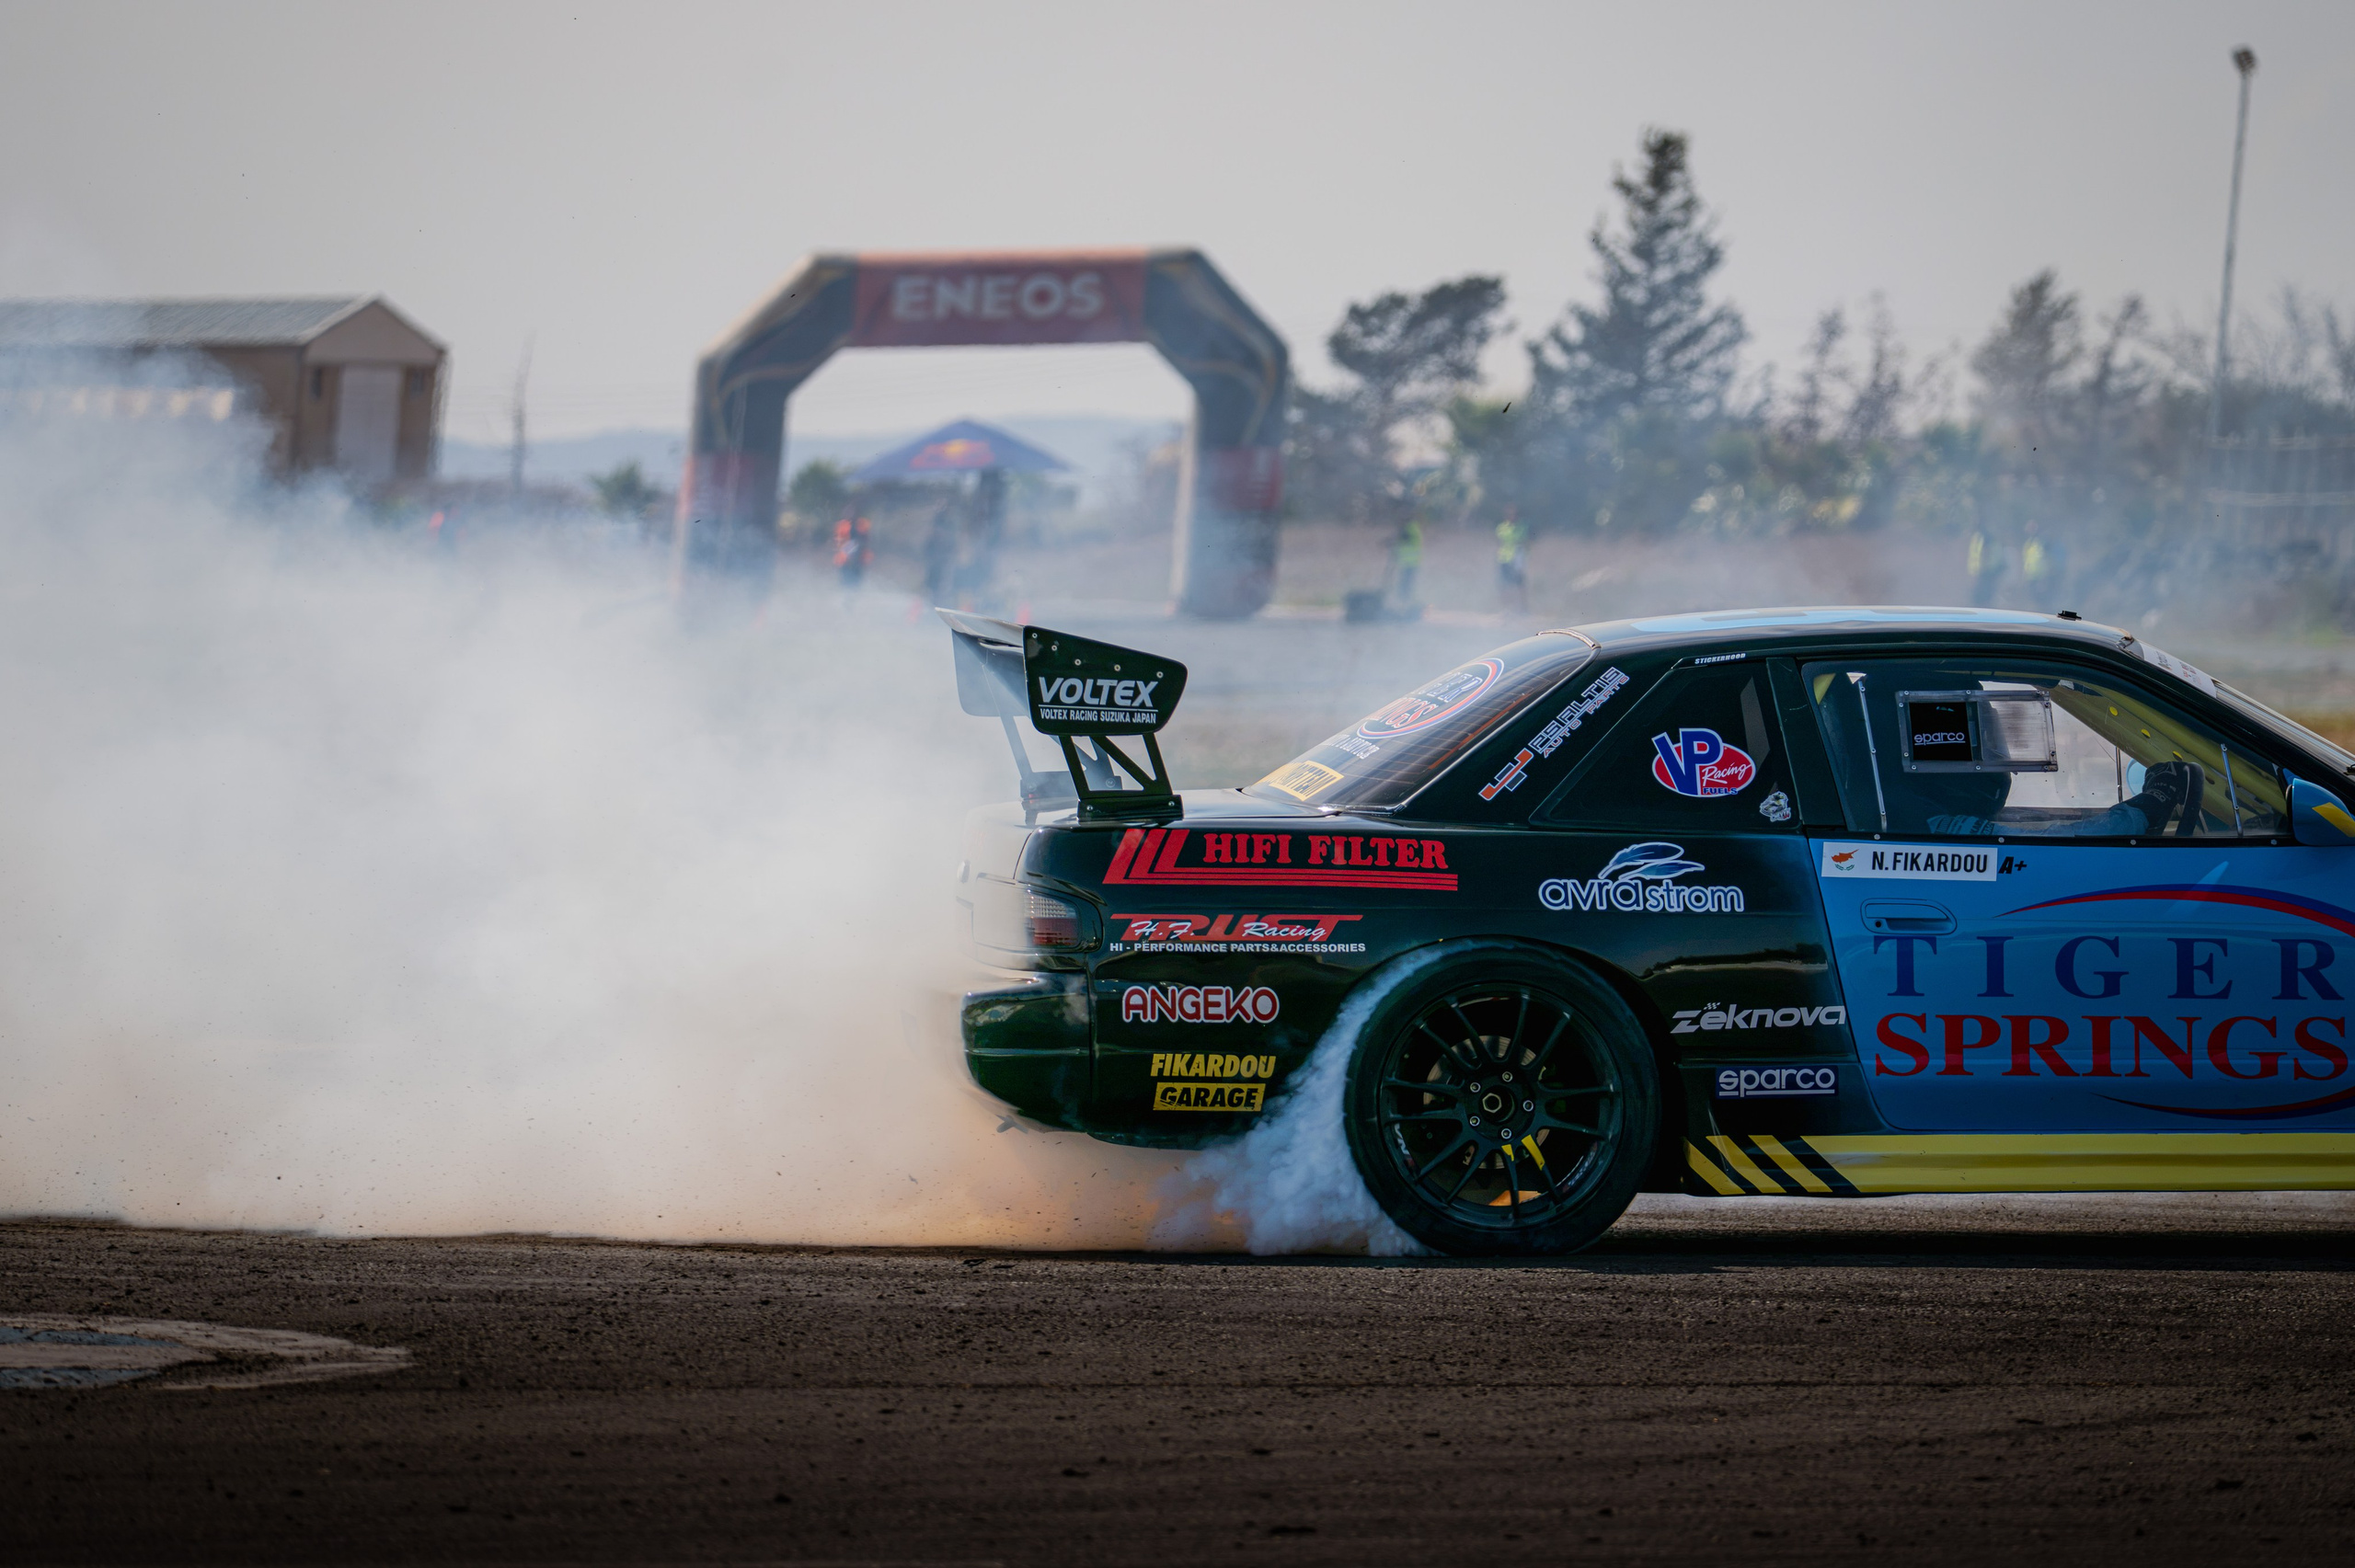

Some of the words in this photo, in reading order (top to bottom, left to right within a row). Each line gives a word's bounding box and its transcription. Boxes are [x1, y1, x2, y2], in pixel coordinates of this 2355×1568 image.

[891, 273, 1103, 322] ENEOS
[1694, 653, 1746, 664] STICKERHOOD
[1039, 677, 1158, 707] VOLTEX
[1040, 708, 1067, 719] VOLTEX
[1100, 711, 1131, 723] SUZUKA
[1132, 713, 1156, 724] JAPAN
[1528, 667, 1626, 754] PSALTIS
[1543, 719, 1582, 759] AUTO
[1587, 675, 1630, 715] PARTS
[1913, 732, 1965, 746] sparco
[1651, 727, 1725, 796] VP
[1702, 762, 1752, 786] Racing
[1202, 832, 1292, 864] HIFI
[1308, 835, 1449, 870] FILTER
[1871, 851, 1988, 873] N.FIKARDOU
[1998, 856, 2028, 875] A+
[1538, 878, 1744, 912] avrastrom
[1110, 913, 1363, 941] TRUST
[1243, 922, 1327, 941] Racing
[1133, 943, 1227, 953] PERFORMANCE
[1230, 943, 1366, 953] PARTS&ACCESSORIES
[1873, 935, 2345, 1001] TIGER
[1122, 986, 1280, 1024] ANGEKO
[1875, 1012, 2349, 1081] SPRINGS
[1151, 1054, 1276, 1078] FIKARDOU
[1160, 1086, 1258, 1110] GARAGE
[1718, 1068, 1835, 1098] sparco
